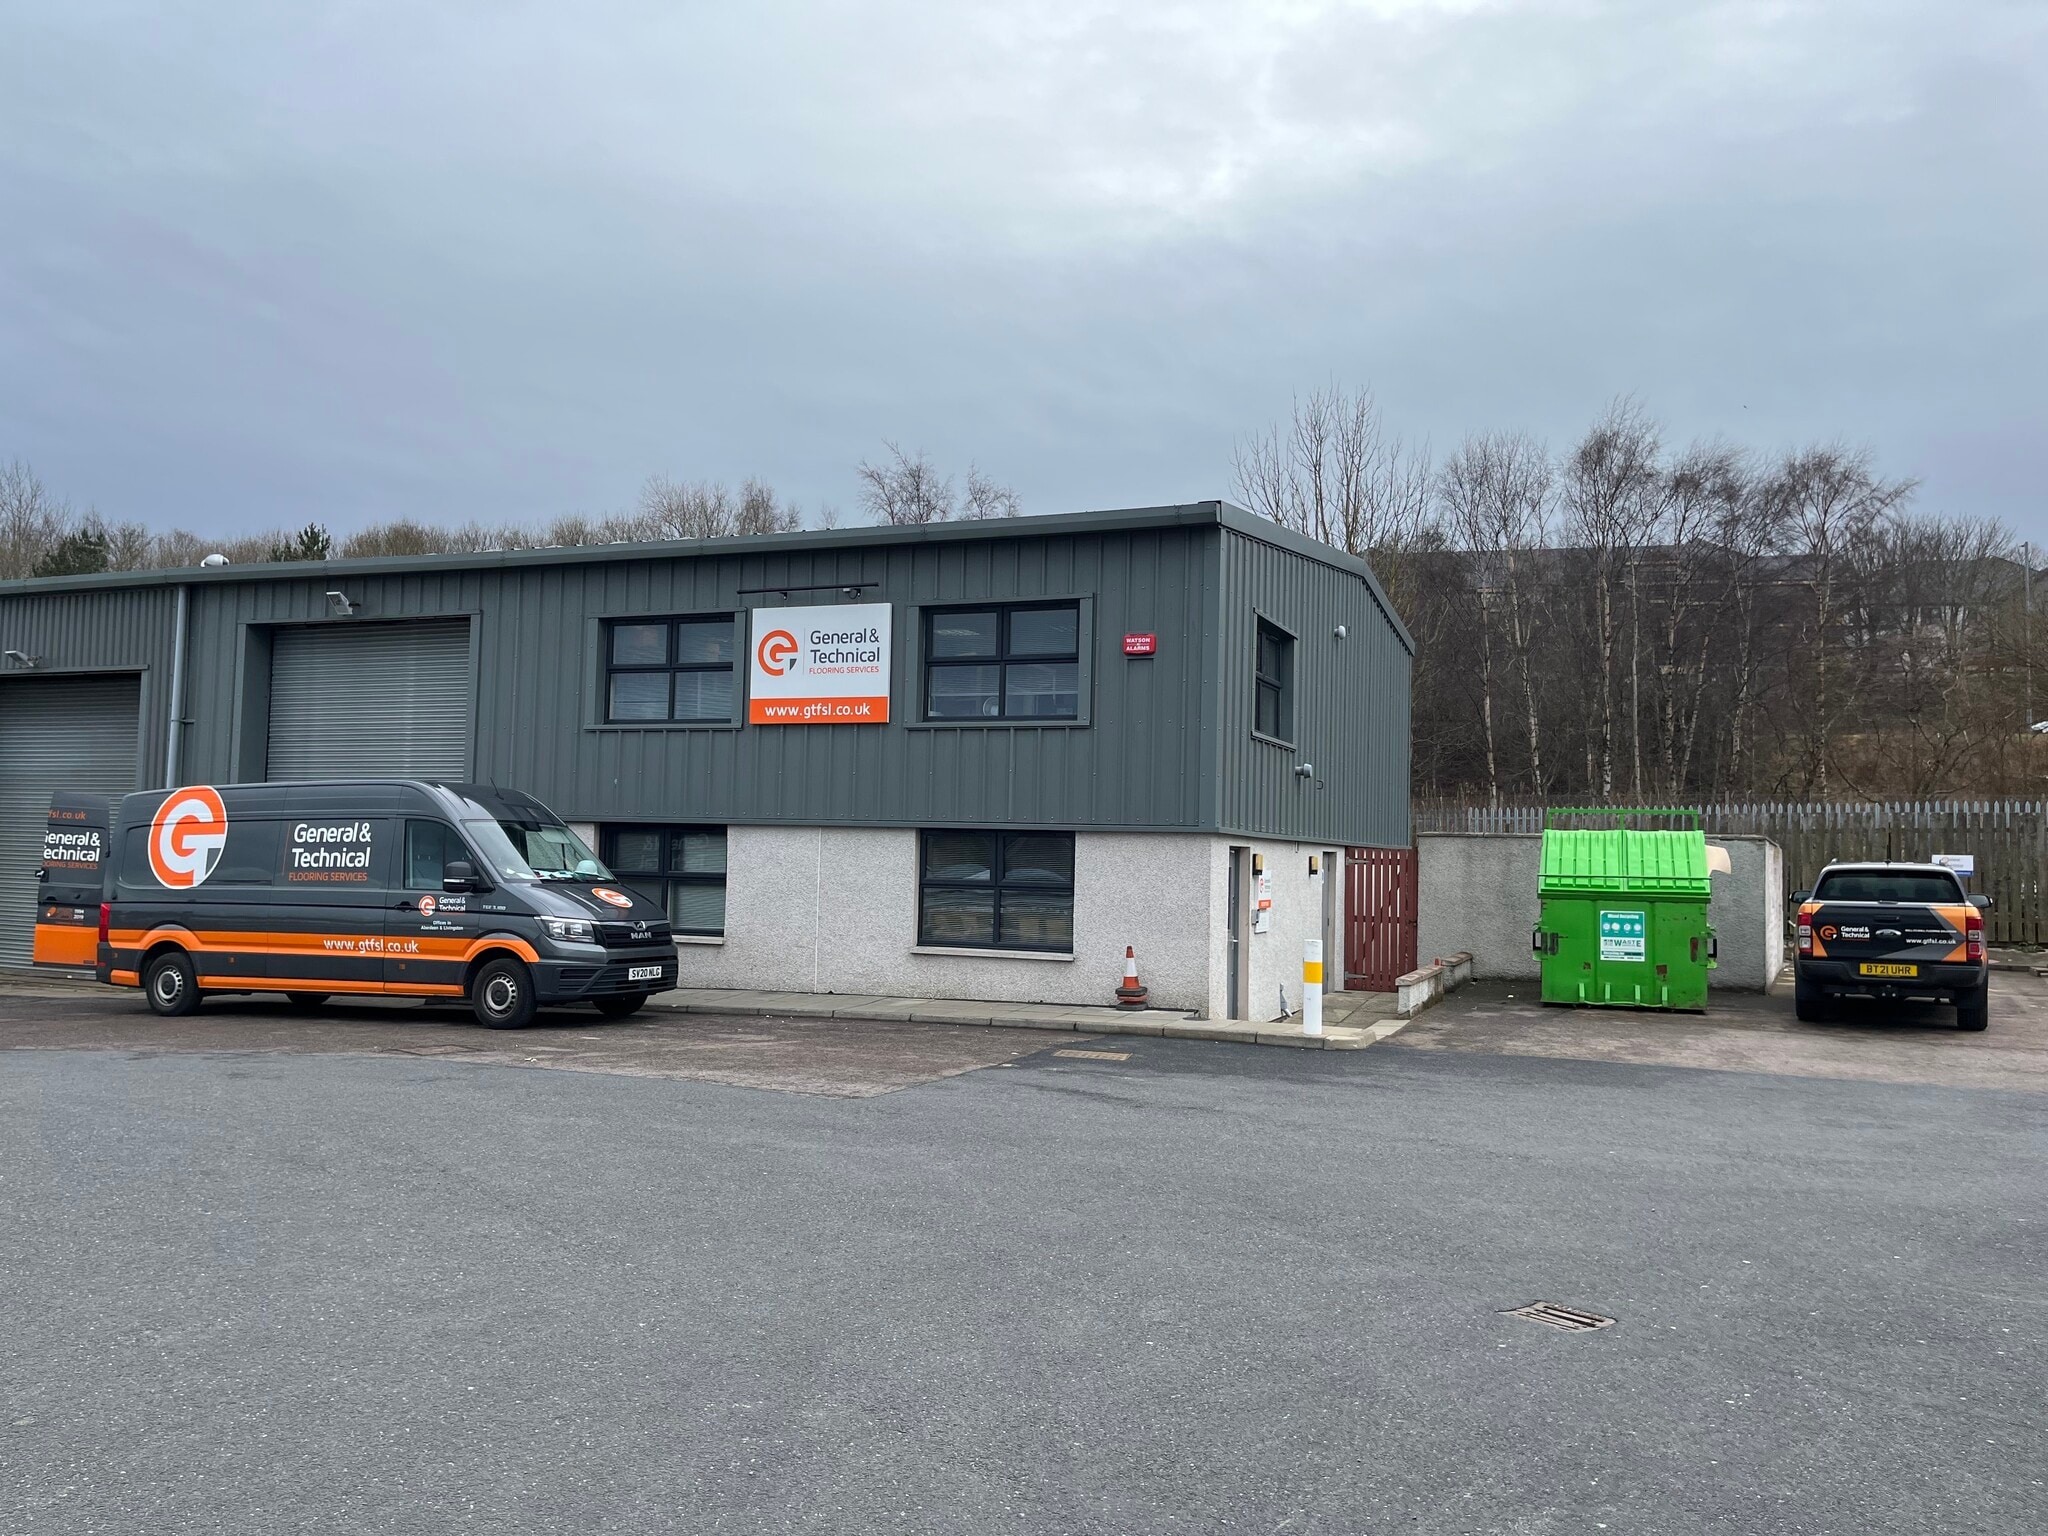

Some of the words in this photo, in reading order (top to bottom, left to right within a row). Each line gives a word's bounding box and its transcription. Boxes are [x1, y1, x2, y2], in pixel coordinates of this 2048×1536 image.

[810, 628, 866, 645] General
[869, 628, 879, 643] &
[810, 647, 880, 664] Technical
[809, 666, 844, 675] FLOORING
[847, 666, 879, 674] SERVICES
[765, 703, 870, 719] www.gtfsl.co.uk
[90, 832, 100, 846] &
[294, 822, 359, 843] General
[359, 822, 371, 842] &
[44, 846, 100, 862] echnical
[292, 847, 370, 867] Technical
[289, 872, 328, 881] FLOORING
[330, 872, 368, 881] SERVICES
[324, 938, 419, 954] www.gtfsl.co.uk
[632, 968, 647, 978] SV20
[649, 968, 660, 977] NLG
[1866, 965, 1888, 974] BT21
[1891, 966, 1911, 974] UHR
